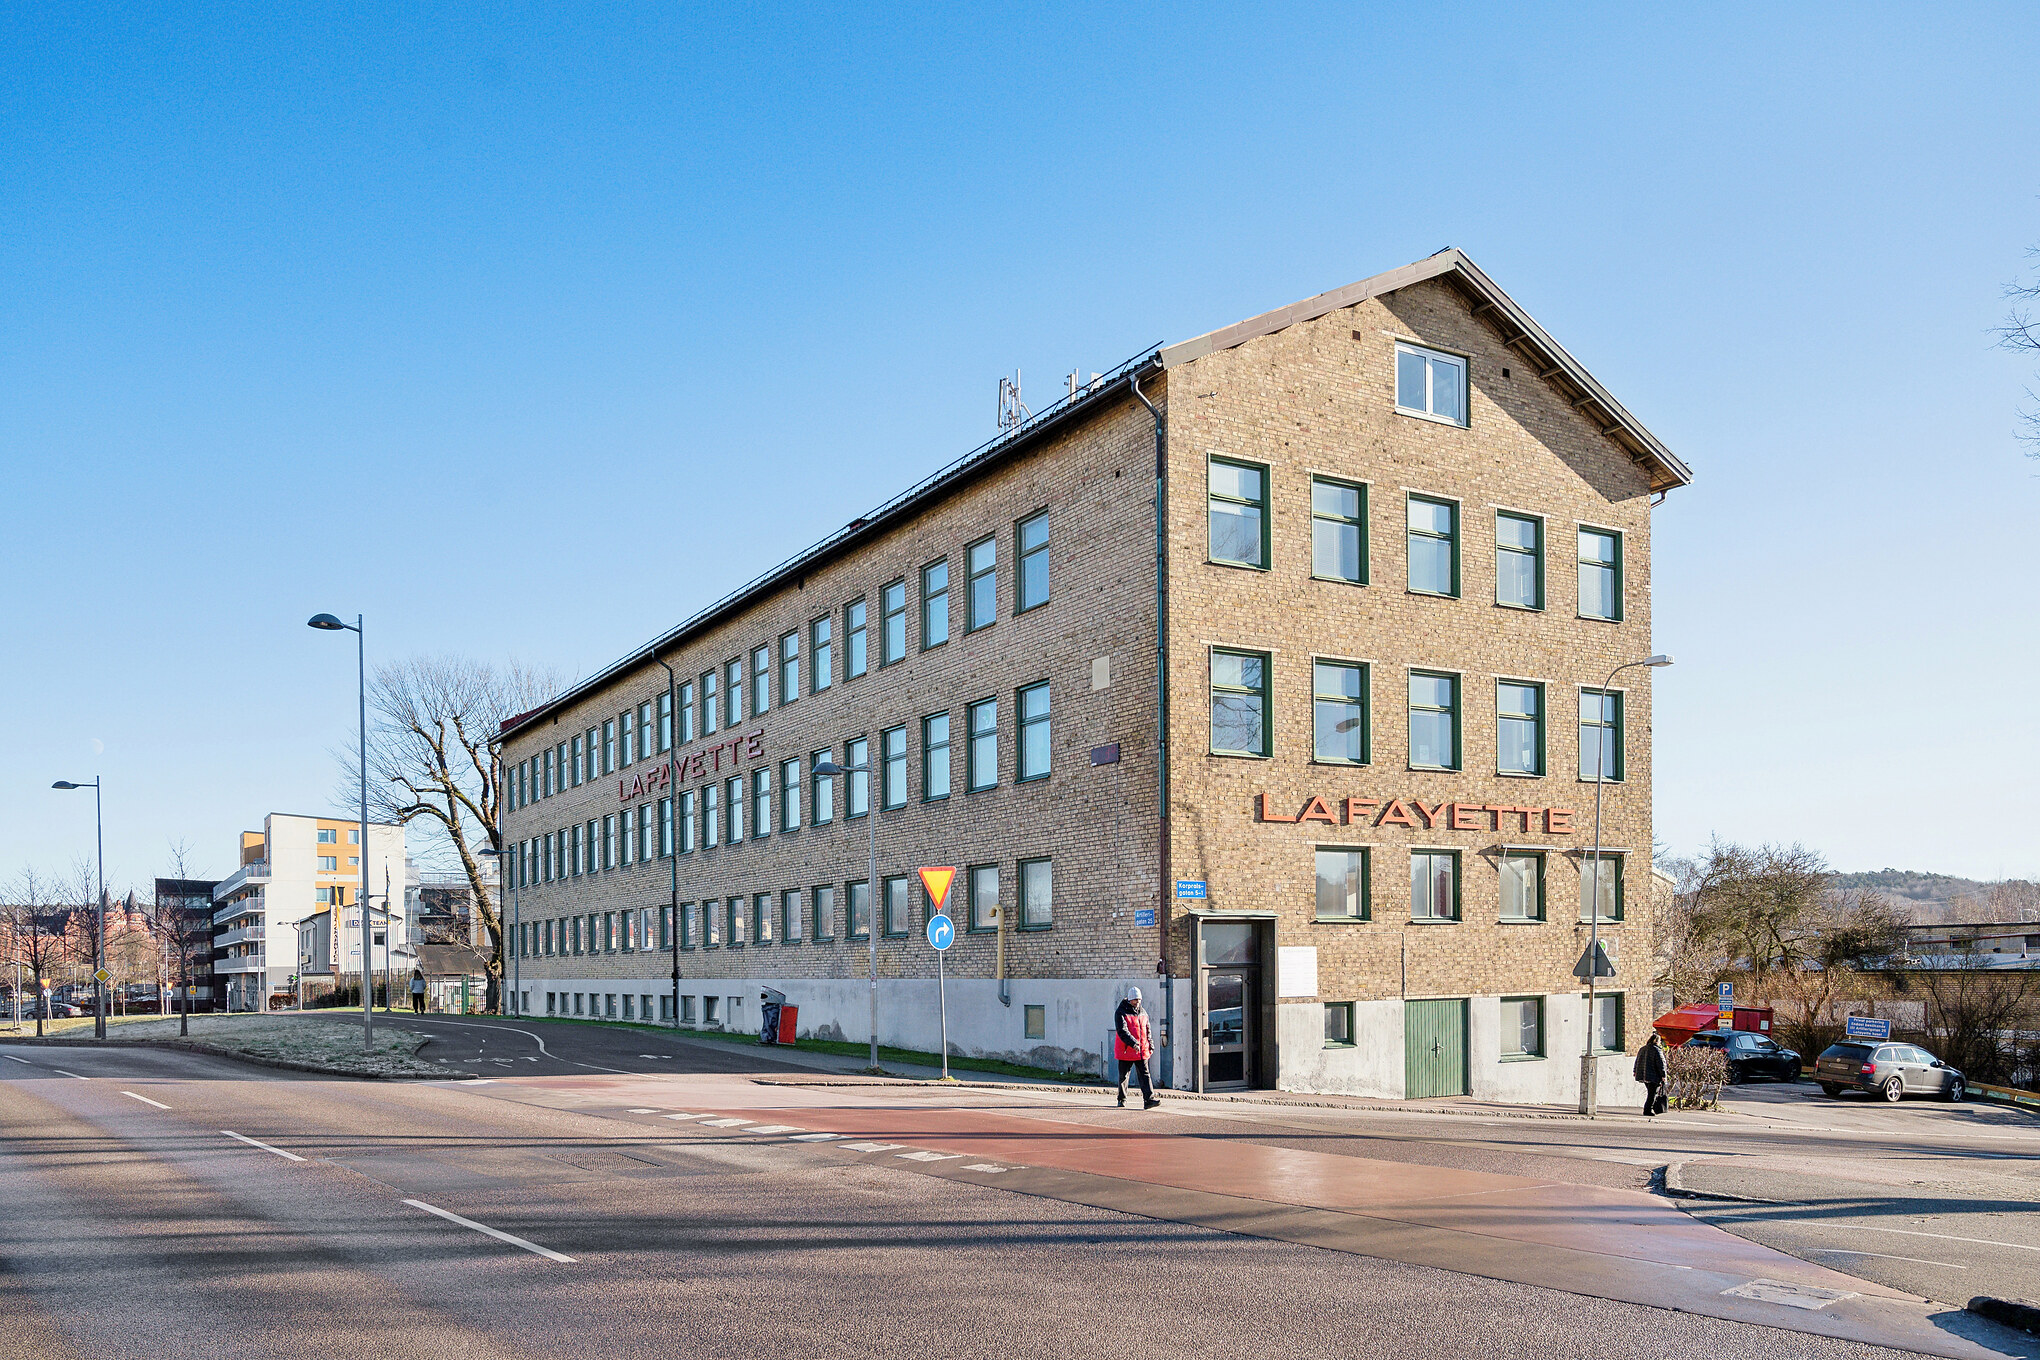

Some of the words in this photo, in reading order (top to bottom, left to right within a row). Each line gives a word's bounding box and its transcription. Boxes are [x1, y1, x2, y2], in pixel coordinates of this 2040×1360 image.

[618, 728, 764, 802] LAFAYETTE
[1261, 792, 1576, 834] LAFAYETTE
[1136, 918, 1147, 926] gatan
[1723, 984, 1730, 994] P
